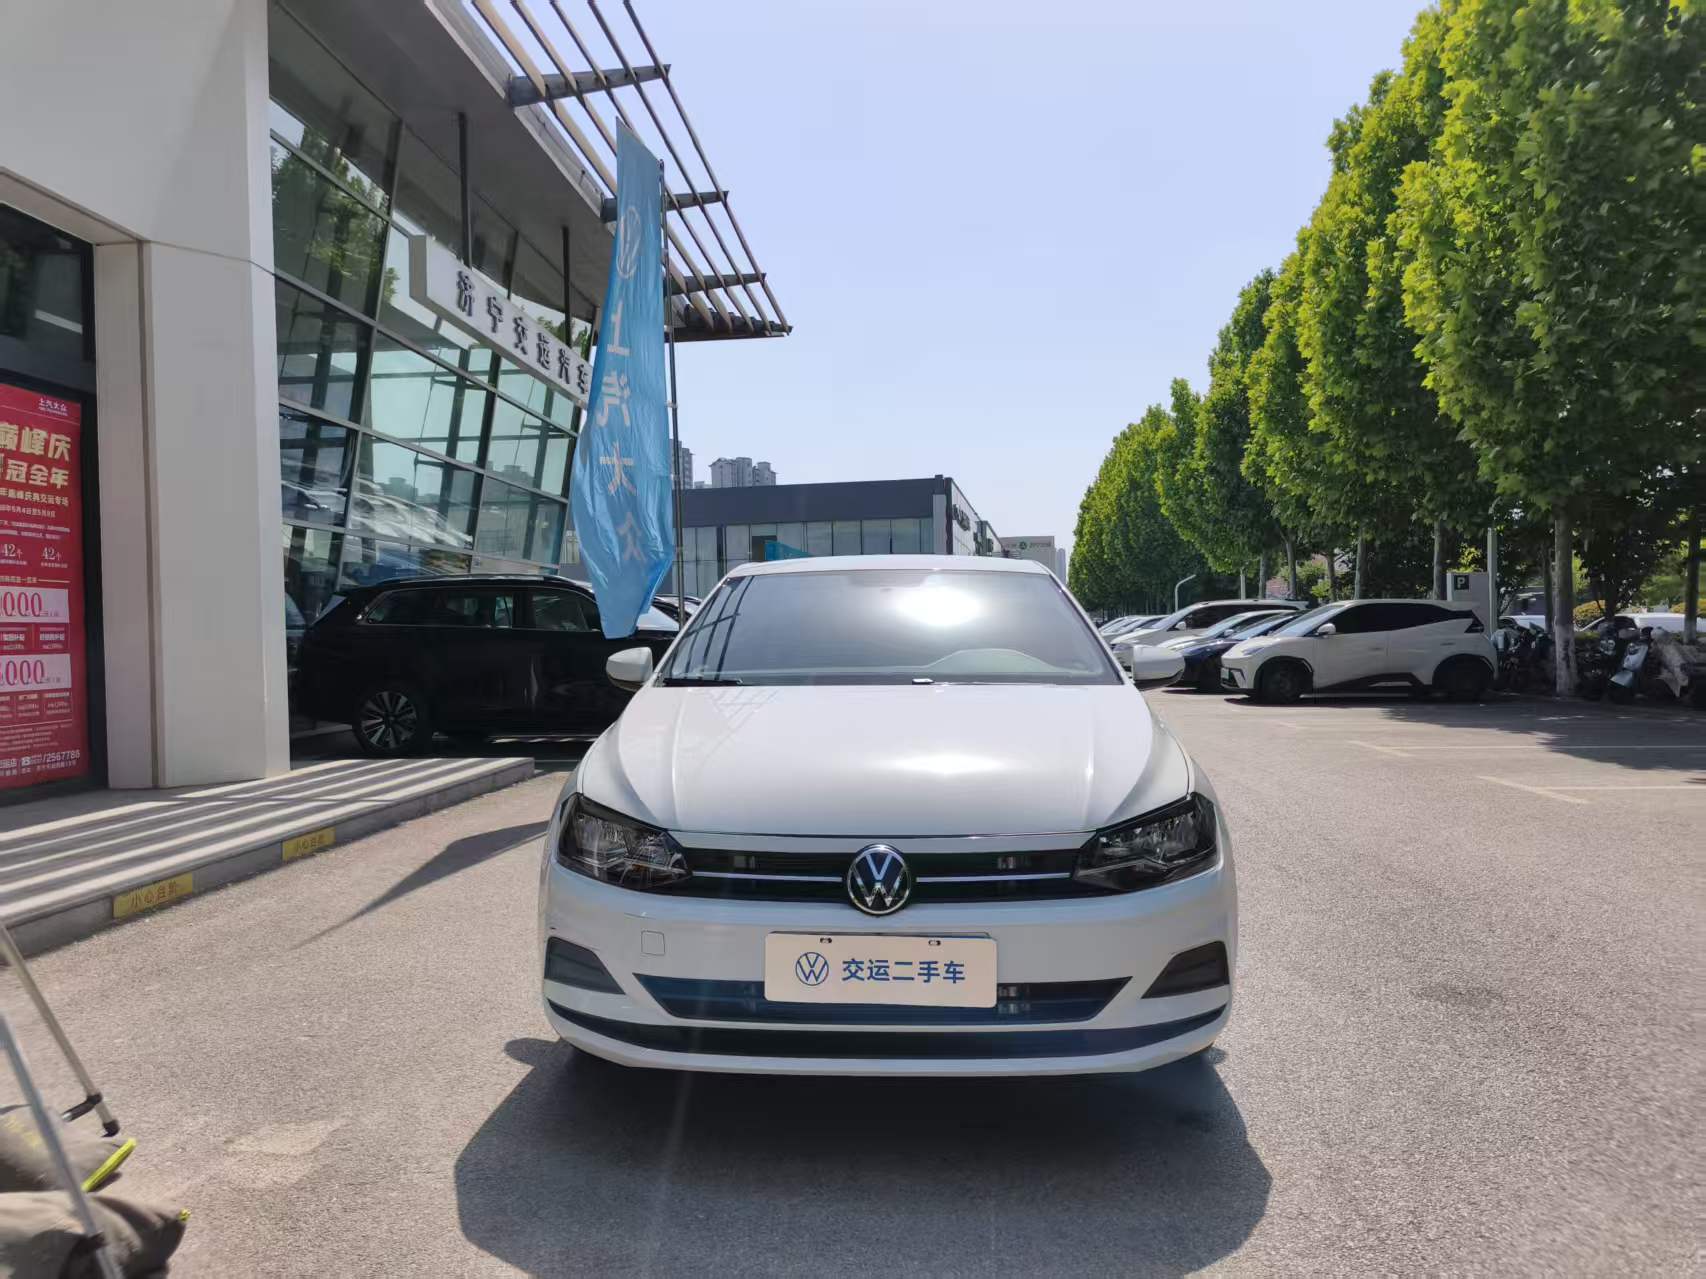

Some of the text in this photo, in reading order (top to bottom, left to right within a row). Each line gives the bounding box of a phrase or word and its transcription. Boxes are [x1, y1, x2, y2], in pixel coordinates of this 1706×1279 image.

[0, 454, 69, 489] 冠全年
[1457, 577, 1466, 589] P
[0, 591, 42, 617] 000
[0, 659, 45, 686] 000
[841, 958, 966, 984] 交运二手车
